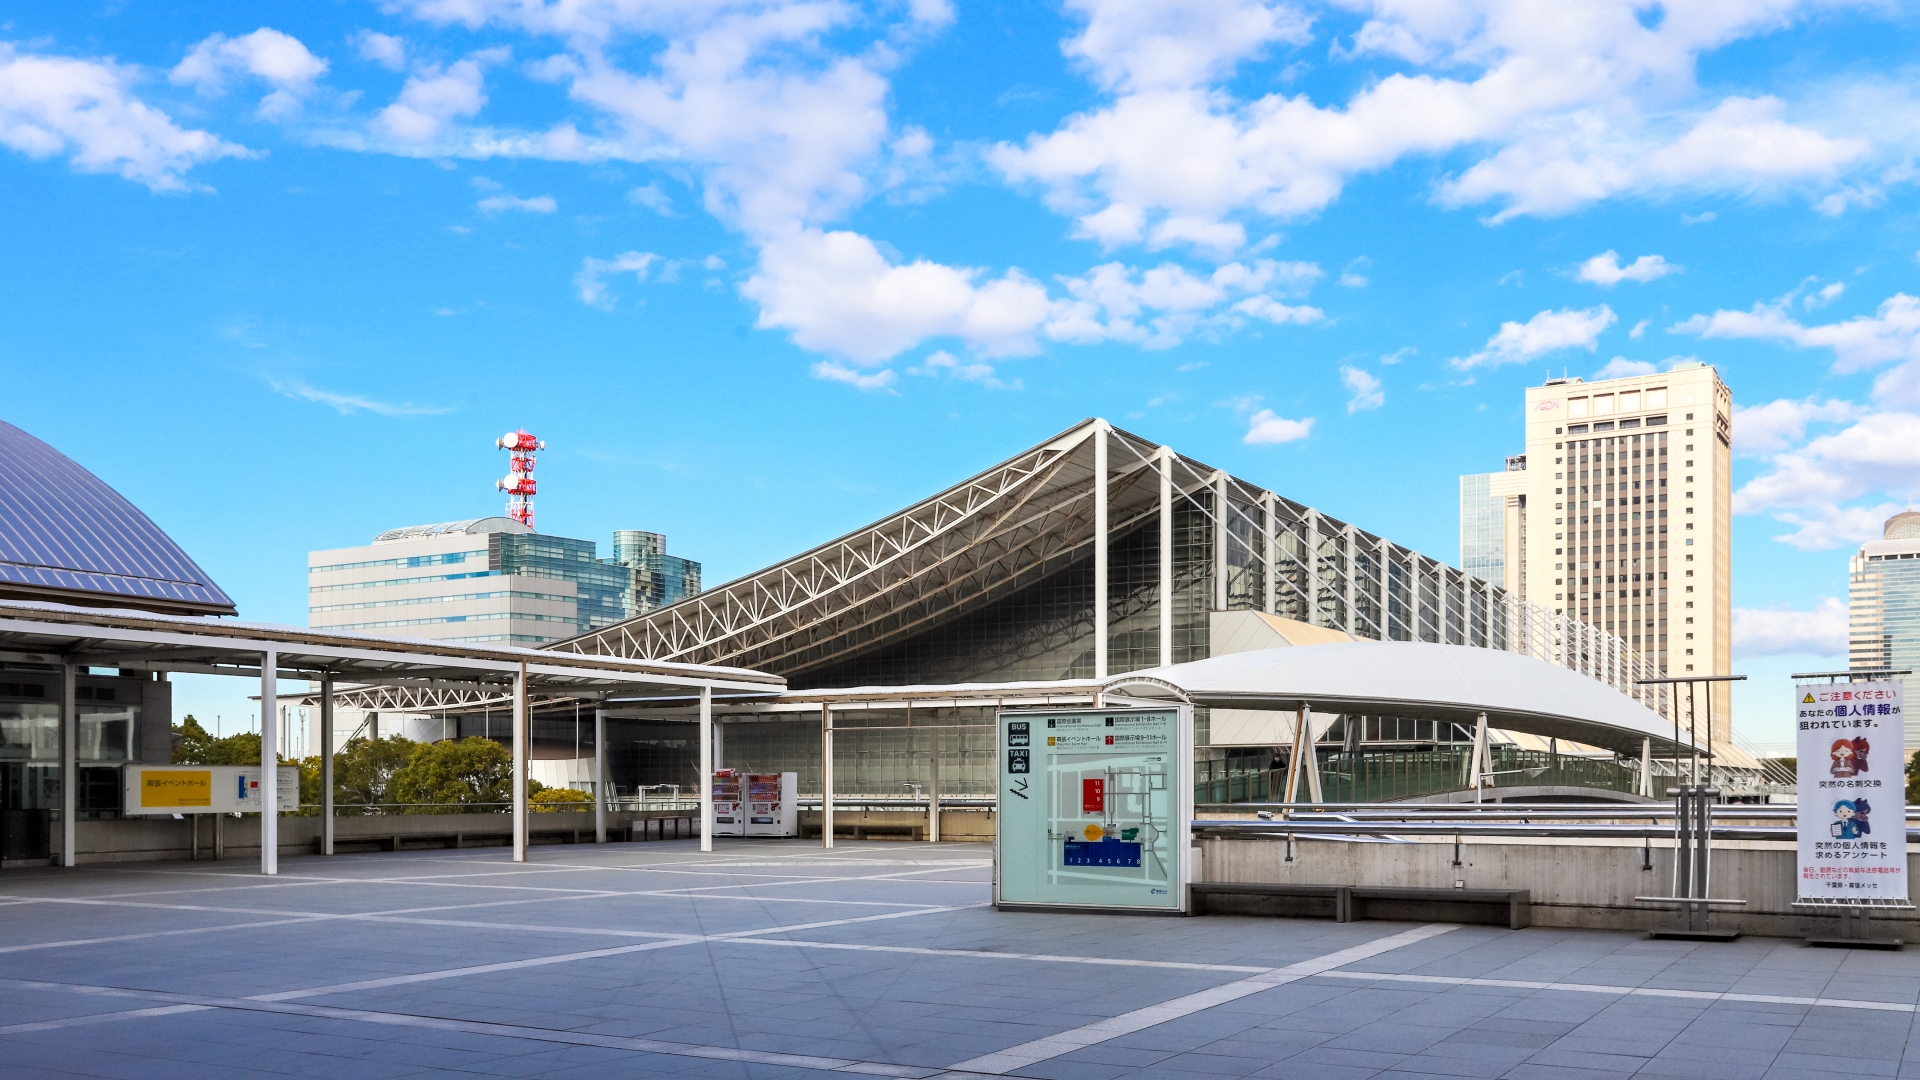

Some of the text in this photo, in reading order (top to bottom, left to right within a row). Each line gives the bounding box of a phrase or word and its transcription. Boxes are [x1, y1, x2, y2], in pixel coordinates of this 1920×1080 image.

[1819, 690, 1897, 702] ご注意ください
[1799, 703, 1901, 718] あなたの個人情報が
[1011, 723, 1027, 731] BUS
[1799, 719, 1879, 731] 狙われています。
[1010, 750, 1028, 758] TAXI
[147, 779, 207, 787] 幕張イベントホール
[1819, 780, 1882, 789] 突然の名刺交換
[1815, 841, 1887, 850] 突然の個人情報を
[1815, 851, 1888, 860] 求めるアンケート
